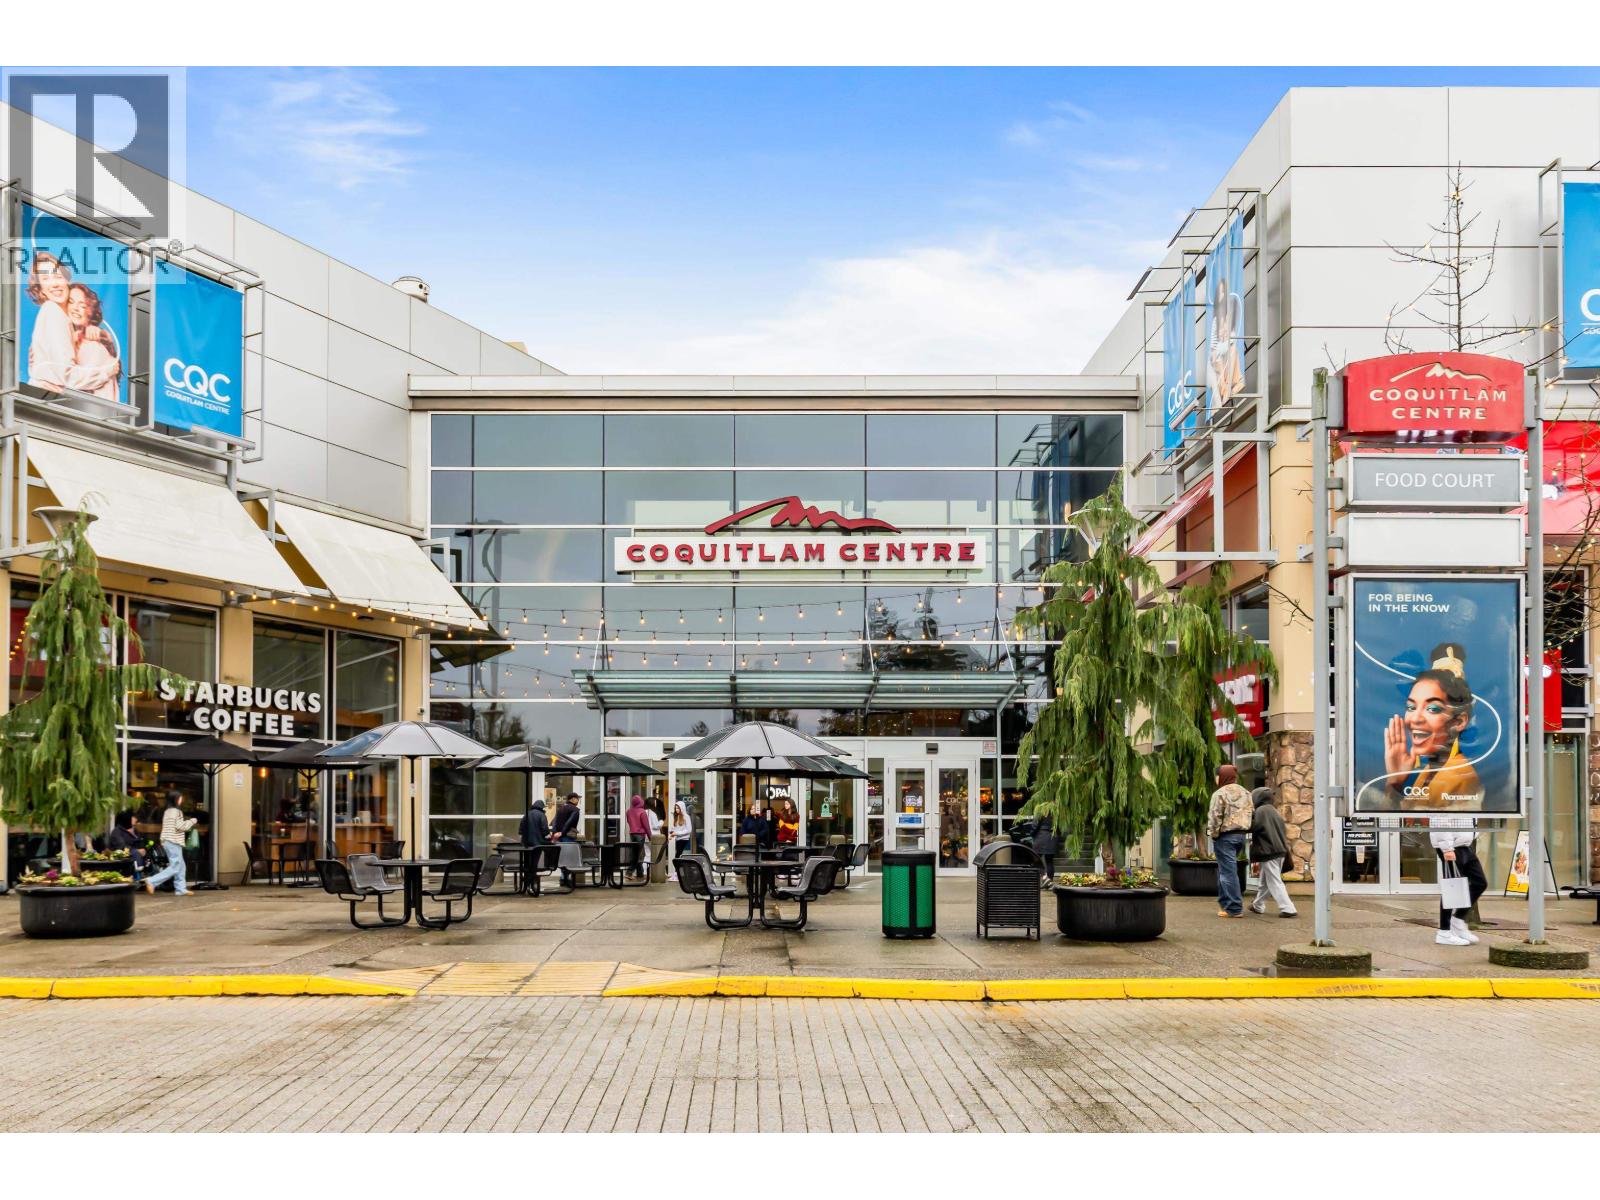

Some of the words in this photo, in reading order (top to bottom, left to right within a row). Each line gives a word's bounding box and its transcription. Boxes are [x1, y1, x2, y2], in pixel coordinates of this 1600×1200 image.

[164, 357, 231, 402] CQC
[1369, 388, 1507, 402] COQUITLAM
[204, 402, 231, 415] CENTRE
[1391, 406, 1487, 420] CENTRE
[1375, 472, 1427, 488] FOOD
[1432, 472, 1496, 488] COURT
[626, 543, 825, 565] COQUITLAM
[839, 543, 975, 562] CENTRE
[1368, 593, 1393, 603] FOR
[1396, 593, 1434, 603] BEING
[1368, 603, 1381, 613] IN
[1384, 603, 1409, 613] THE
[1412, 603, 1450, 613] KNOW
[159, 677, 322, 714] STARBUCKS
[193, 706, 295, 736] COFFEE
[1403, 786, 1430, 796] CQC
